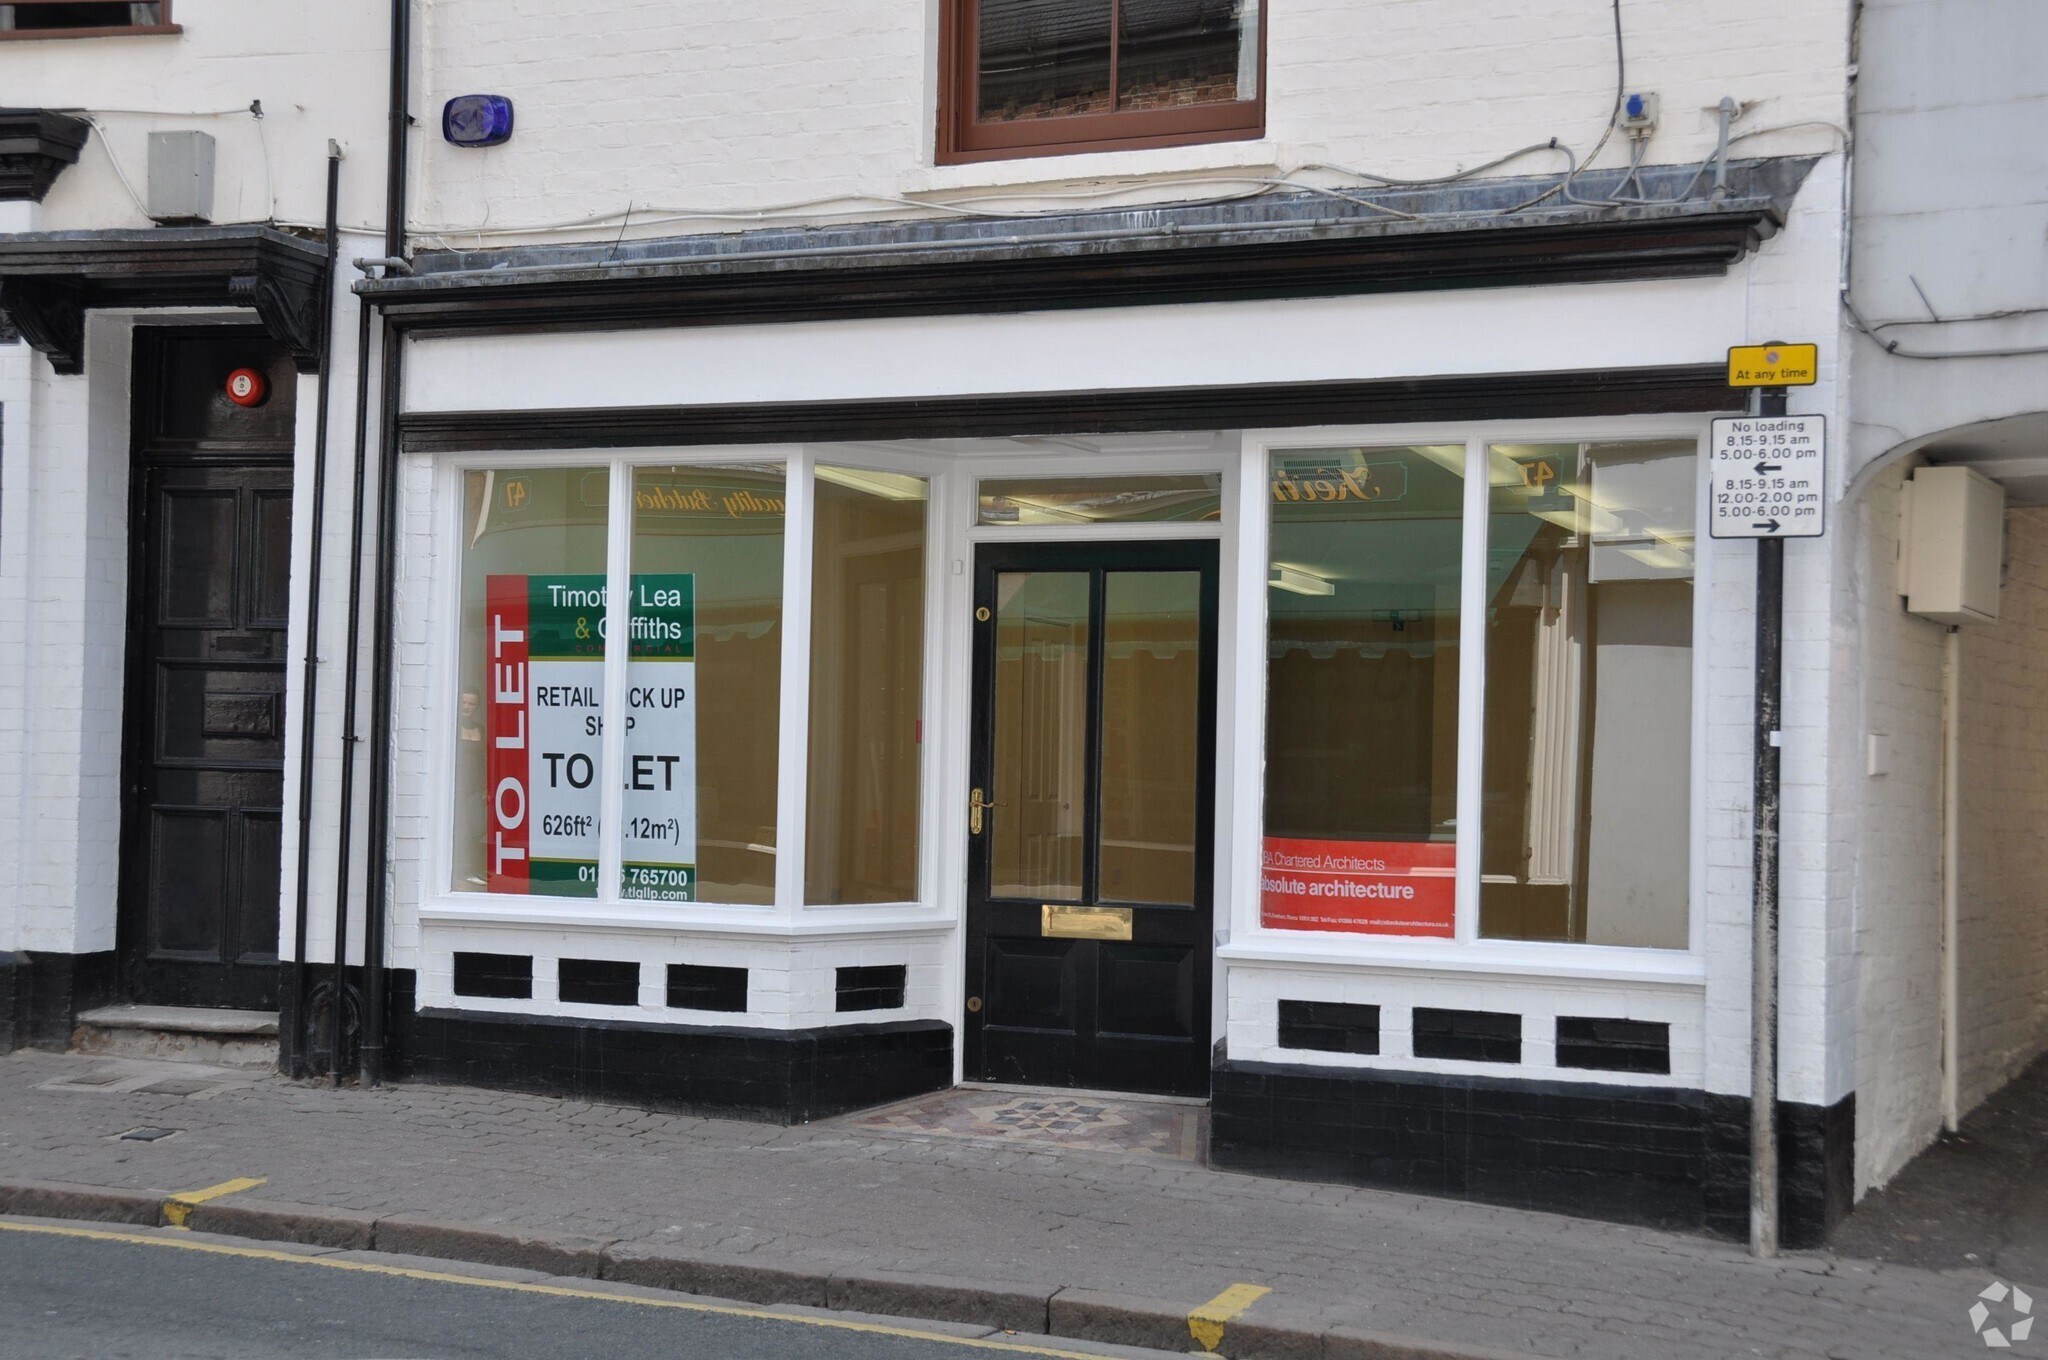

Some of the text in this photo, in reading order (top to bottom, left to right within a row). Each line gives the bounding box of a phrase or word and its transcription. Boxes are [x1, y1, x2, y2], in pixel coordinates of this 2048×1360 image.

[1736, 368, 1808, 381] At any time
[1731, 420, 1805, 433] No loading
[1726, 434, 1810, 446] 8.15-9.15 am
[1719, 448, 1817, 460] 5.00-6.00 pm
[1725, 478, 1809, 490] 8.15-9.15 am
[1717, 491, 1818, 504] 12.00-2.00 pm
[1718, 505, 1816, 517] 5.00-6.00 pm
[640, 584, 681, 607] Lea
[575, 616, 590, 639] &
[537, 686, 599, 707] RETAIL
[661, 687, 686, 709] UP
[495, 614, 526, 875] TO LET
[542, 752, 680, 791] TO ET
[1274, 851, 1321, 868] Chartered
[1323, 854, 1386, 871] Architects
[630, 868, 688, 887] 765700
[1309, 879, 1415, 900] architecture
